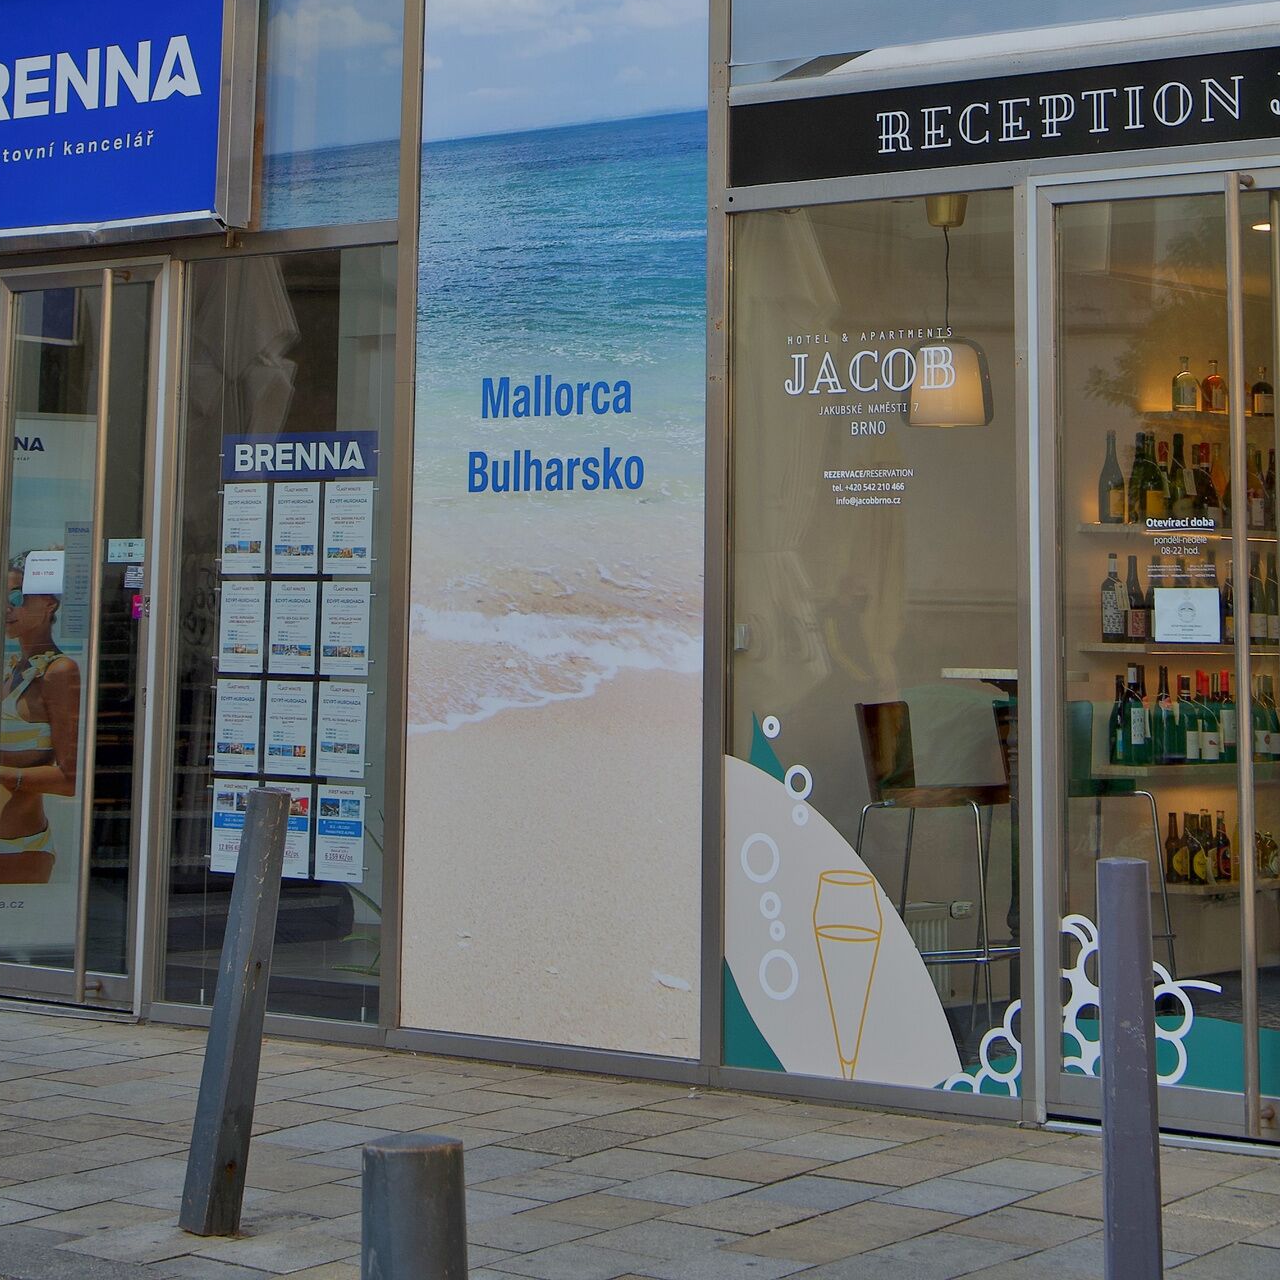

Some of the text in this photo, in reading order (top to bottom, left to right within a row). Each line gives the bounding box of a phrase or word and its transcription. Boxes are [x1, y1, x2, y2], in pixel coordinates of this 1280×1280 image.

[877, 74, 1246, 154] RECEPTION
[63, 129, 155, 156] kancelář
[787, 327, 953, 345] HOTEL & APARTMENTS
[784, 345, 956, 395] JACOB
[482, 374, 632, 418] Mallorca
[851, 420, 887, 435] BRNO
[234, 441, 366, 471] BRENNA
[468, 447, 645, 492] Bulharsko
[824, 469, 914, 478] REZERVACE/RESERVATION
[1146, 517, 1214, 527] Otevírací doba
[1161, 546, 1200, 555] 08-22 hod.
